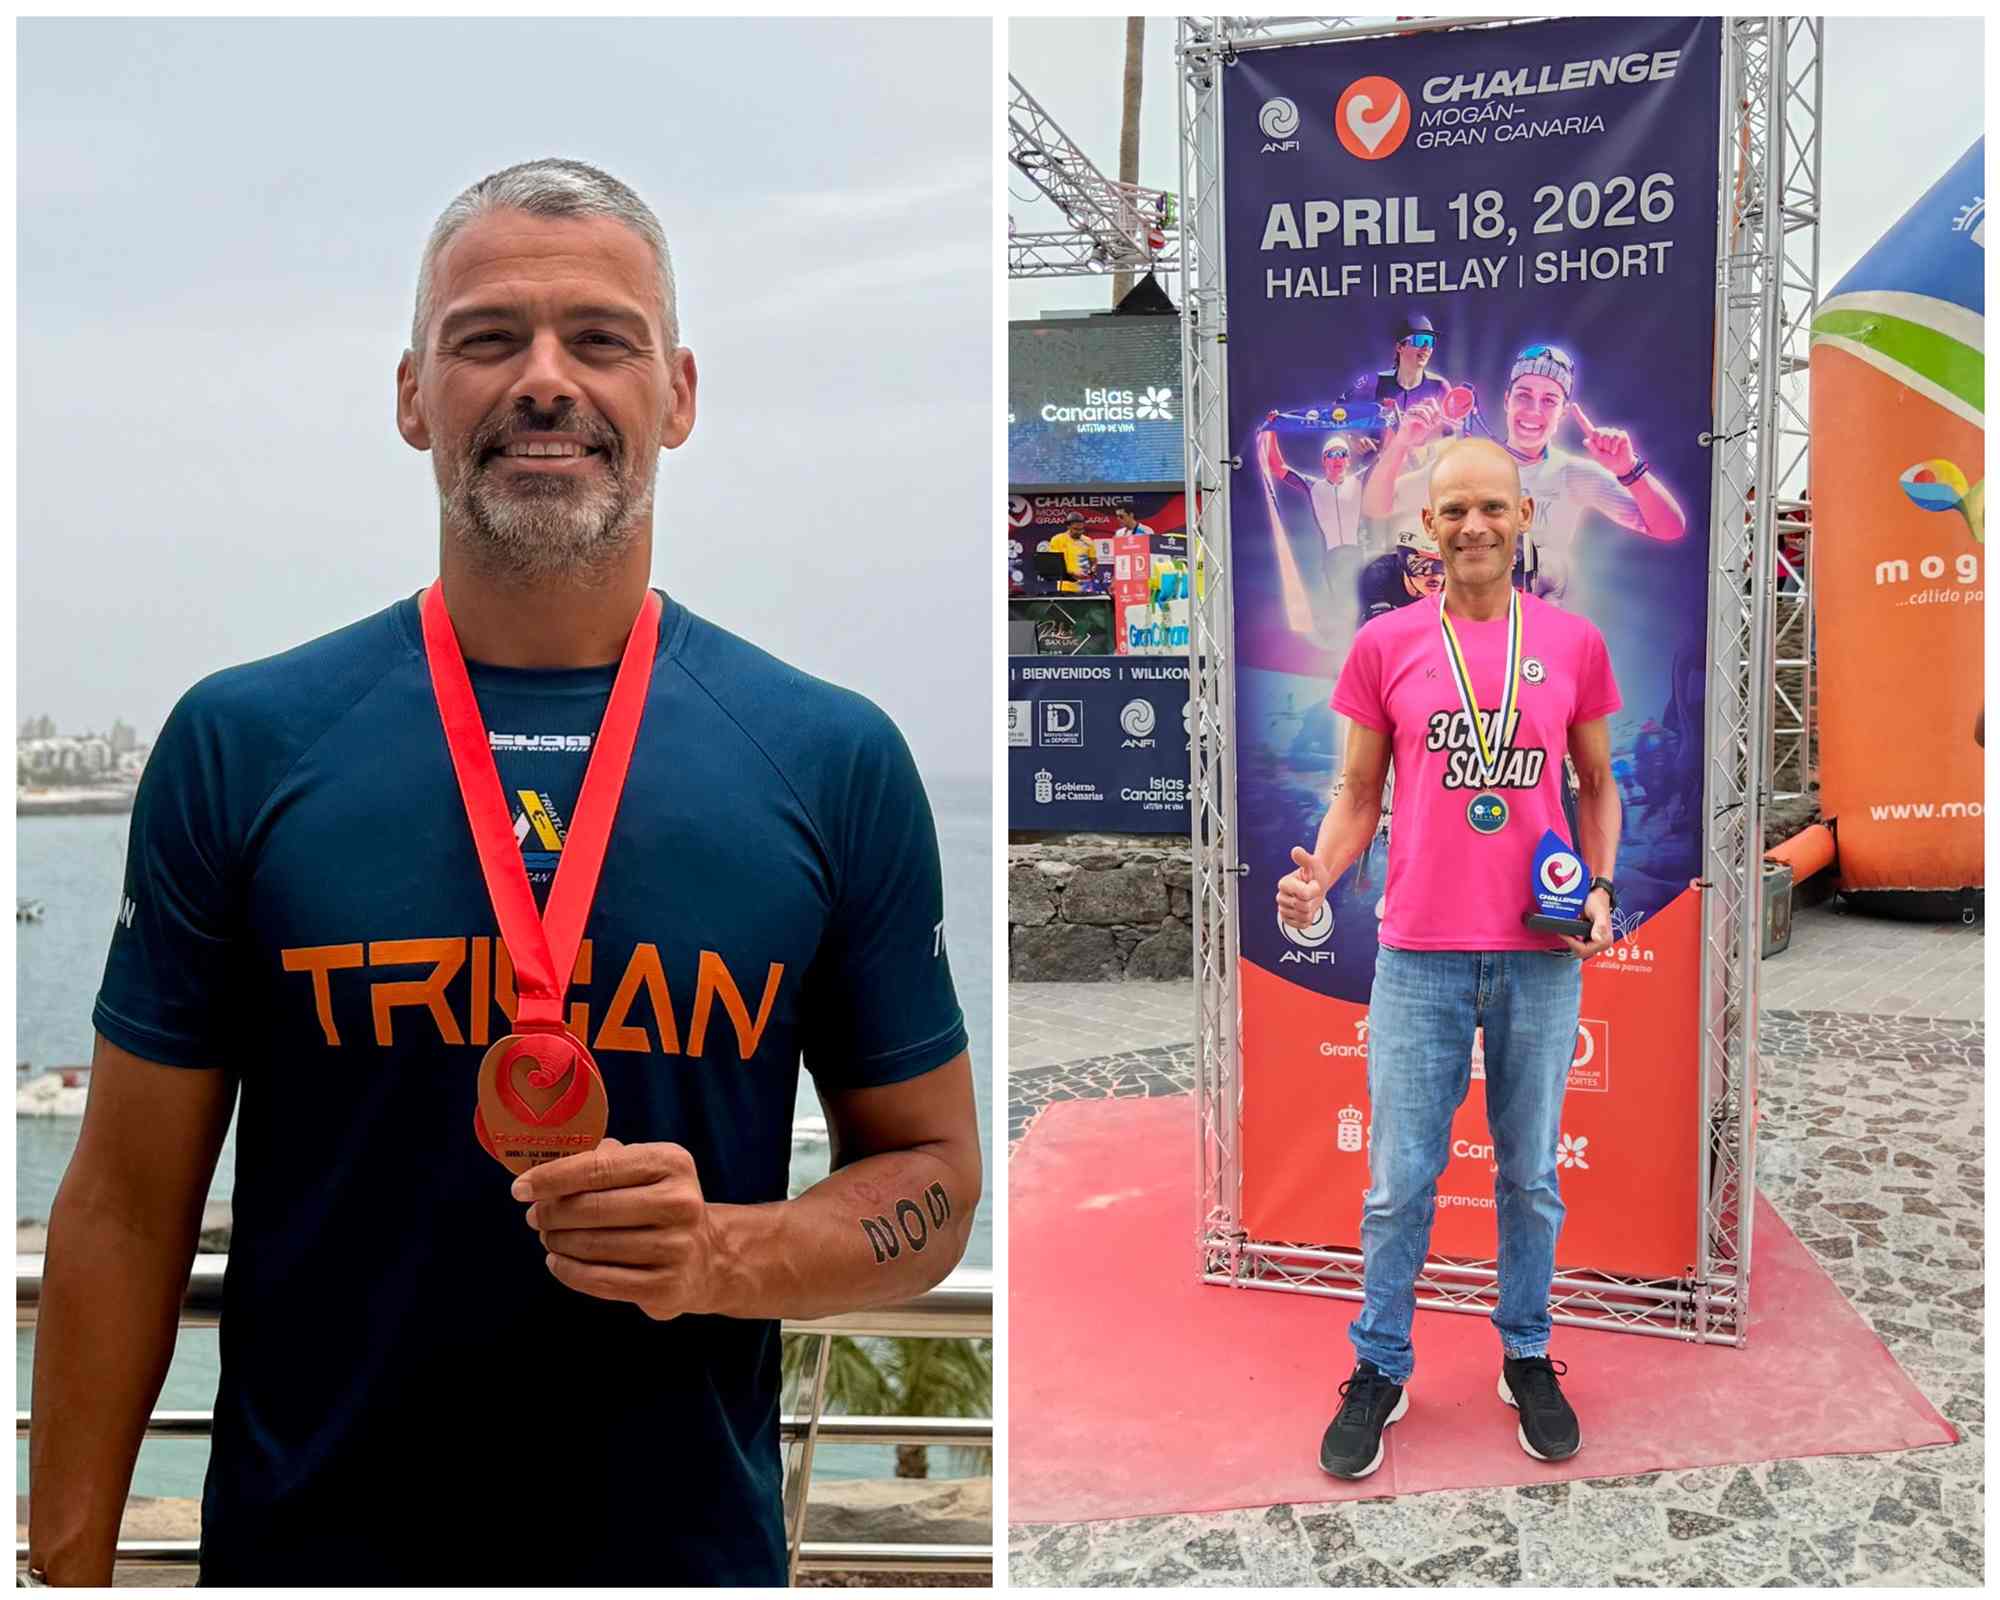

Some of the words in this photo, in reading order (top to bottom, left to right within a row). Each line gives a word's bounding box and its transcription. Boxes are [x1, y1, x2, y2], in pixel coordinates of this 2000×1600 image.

[1421, 49, 1682, 105] CHALLENGE
[1419, 100, 1526, 128] MOGÁN-
[1415, 127, 1487, 150] GRAN
[1493, 114, 1606, 143] CANARIA
[1260, 140, 1300, 154] ANFI
[1259, 196, 1436, 251] APRIL
[1448, 189, 1518, 247] 18,
[1532, 171, 1676, 236] 2026
[1265, 264, 1362, 299] HALF
[1389, 255, 1509, 295] RELAY
[1533, 240, 1674, 284] SHORT
[1085, 387, 1134, 405] Islas
[1041, 404, 1135, 422] Canarias
[1875, 554, 1977, 584] mog
[1022, 667, 1112, 681] BIENVENIDOS
[1120, 738, 1156, 749] ANFI
[1055, 782, 1095, 792] Gobierno
[1150, 776, 1184, 790] Islas
[1067, 791, 1104, 801] Canarias
[1120, 788, 1185, 802] Canarias
[1869, 801, 1984, 821] www.mo
[1279, 950, 1335, 965] ANFI
[860, 1181, 952, 1264] 205
